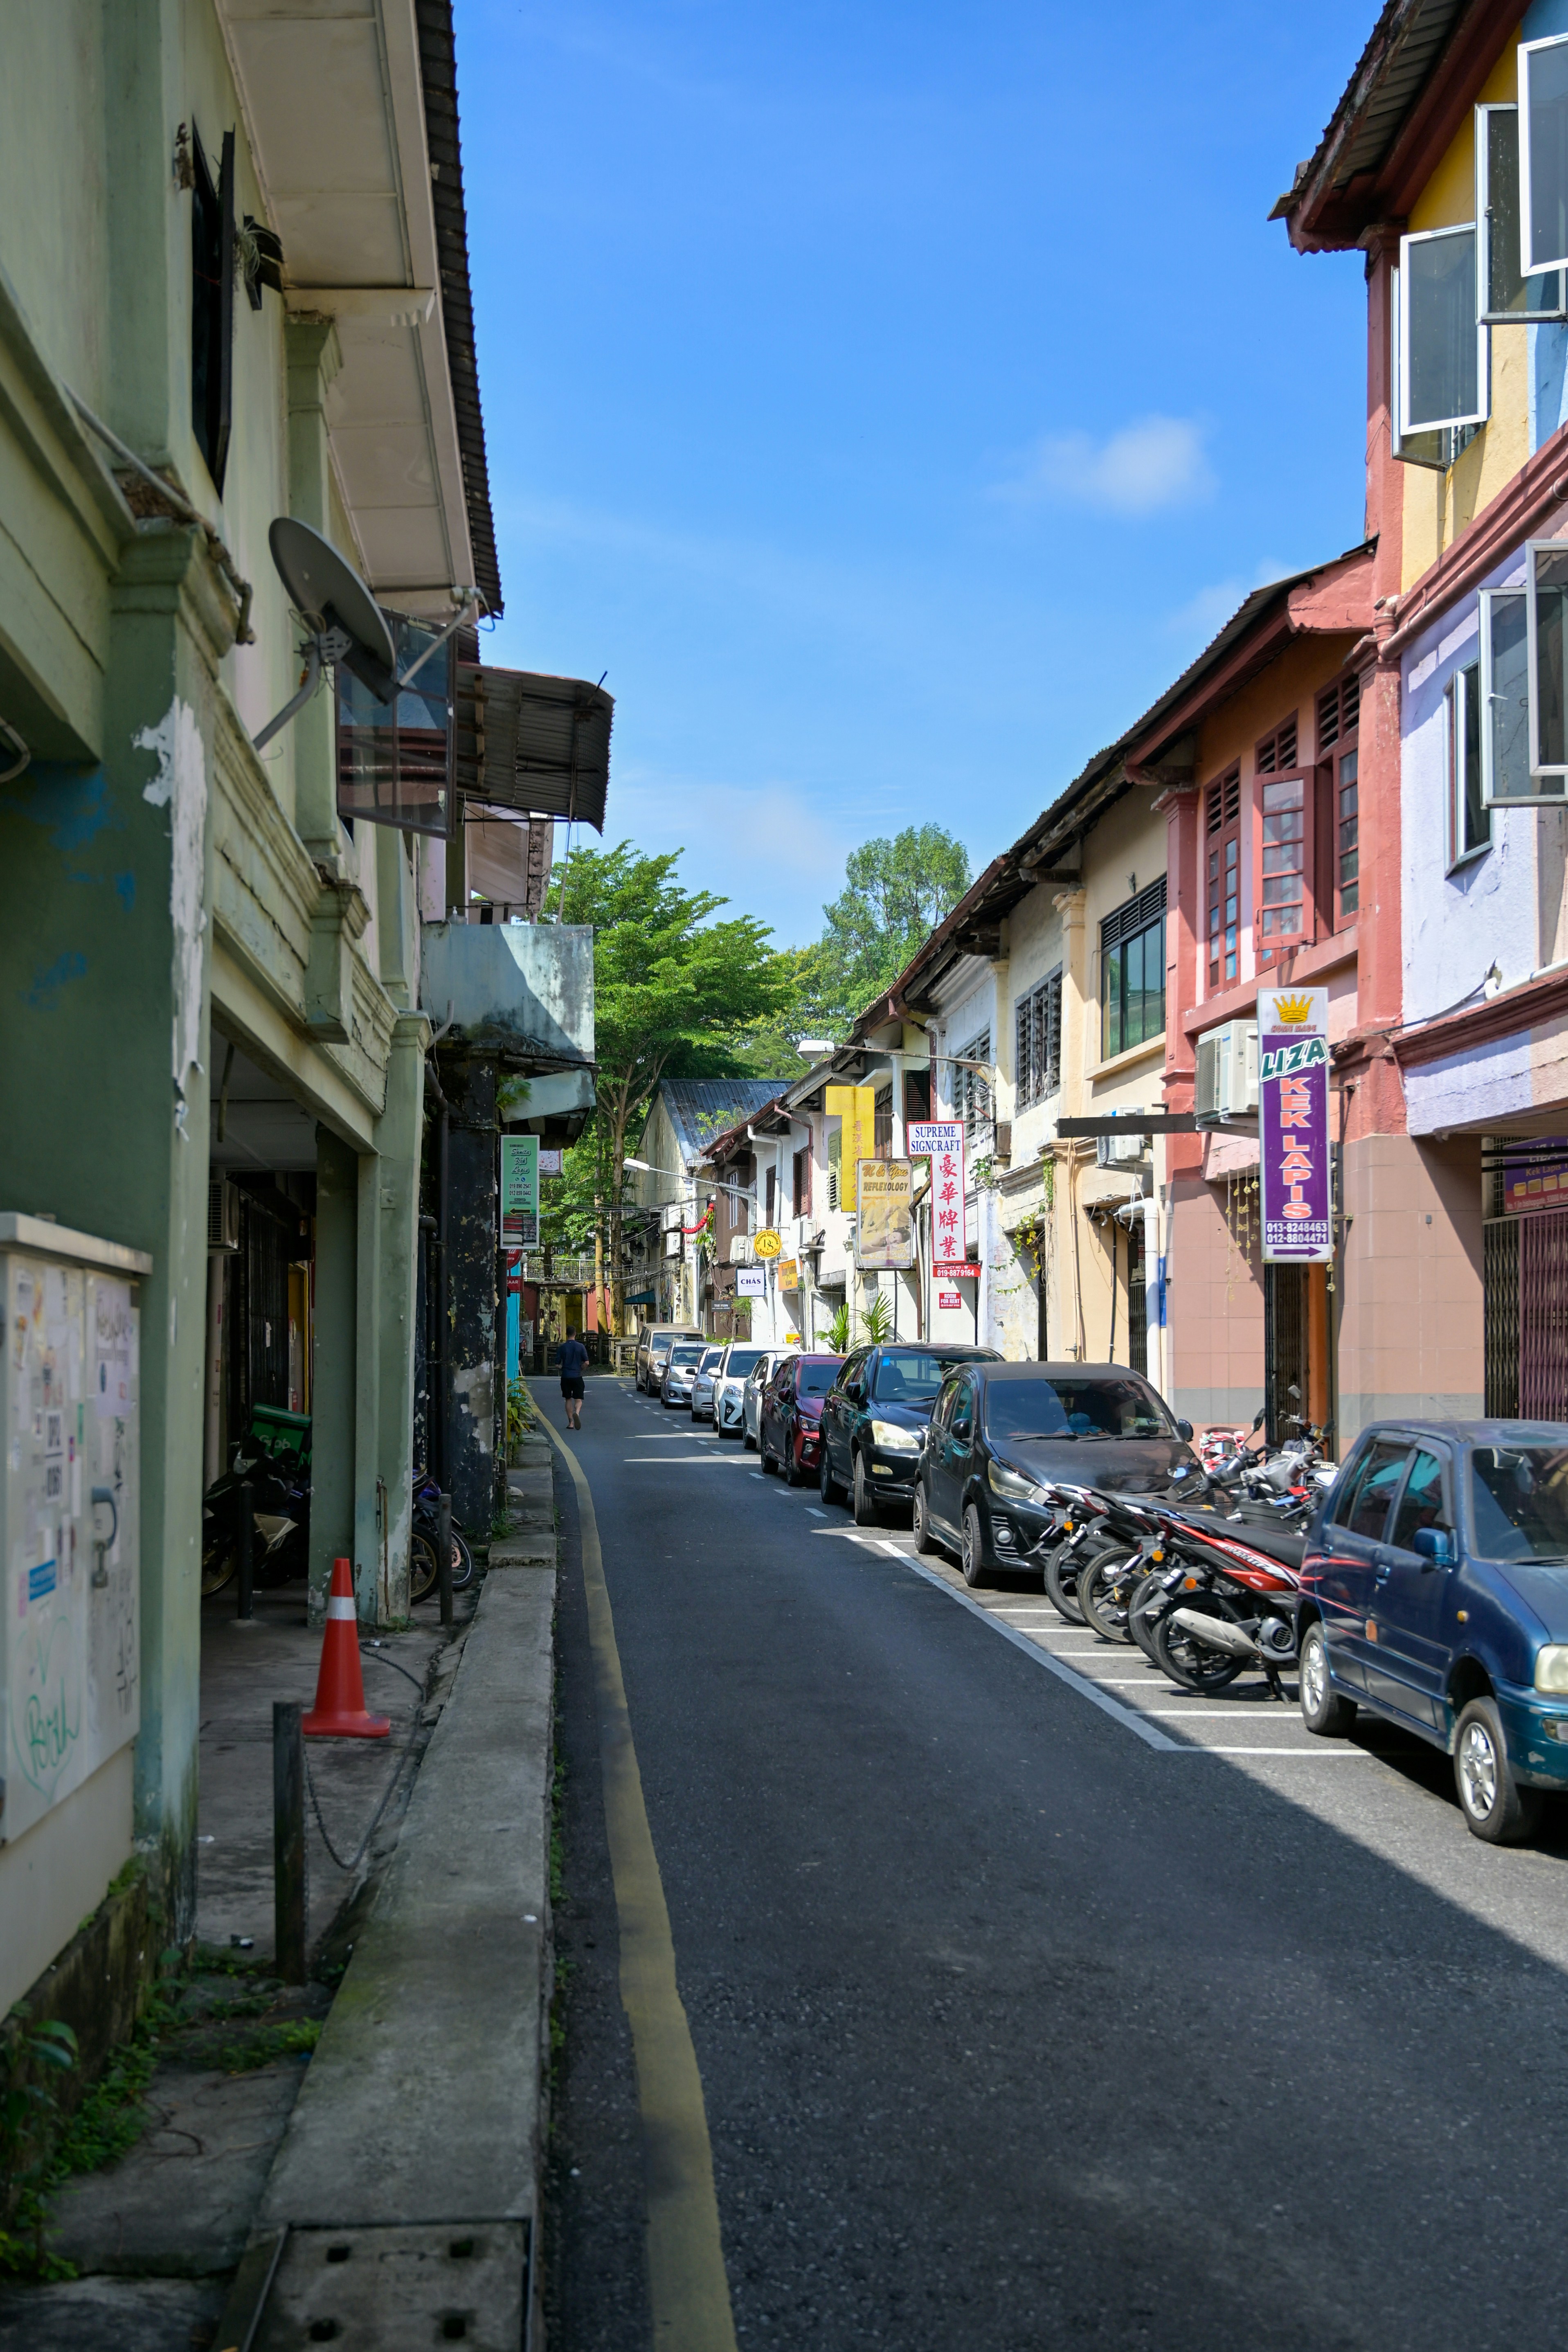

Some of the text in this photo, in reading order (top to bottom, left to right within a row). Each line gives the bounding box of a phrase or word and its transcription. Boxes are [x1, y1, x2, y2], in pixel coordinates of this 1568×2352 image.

[1260, 1037, 1330, 1083] LIZA
[1280, 1077, 1312, 1128] KEK
[916, 1126, 956, 1138] SUPREME
[911, 1140, 961, 1152] SIGNCRAFT
[876, 1164, 885, 1177] &
[888, 1164, 908, 1180] You
[1278, 1135, 1314, 1219] LAPIS
[863, 1182, 908, 1191] REFLEXOLOGY
[1267, 1222, 1327, 1232] 013-8248463
[1267, 1233, 1327, 1243] 012-8804471
